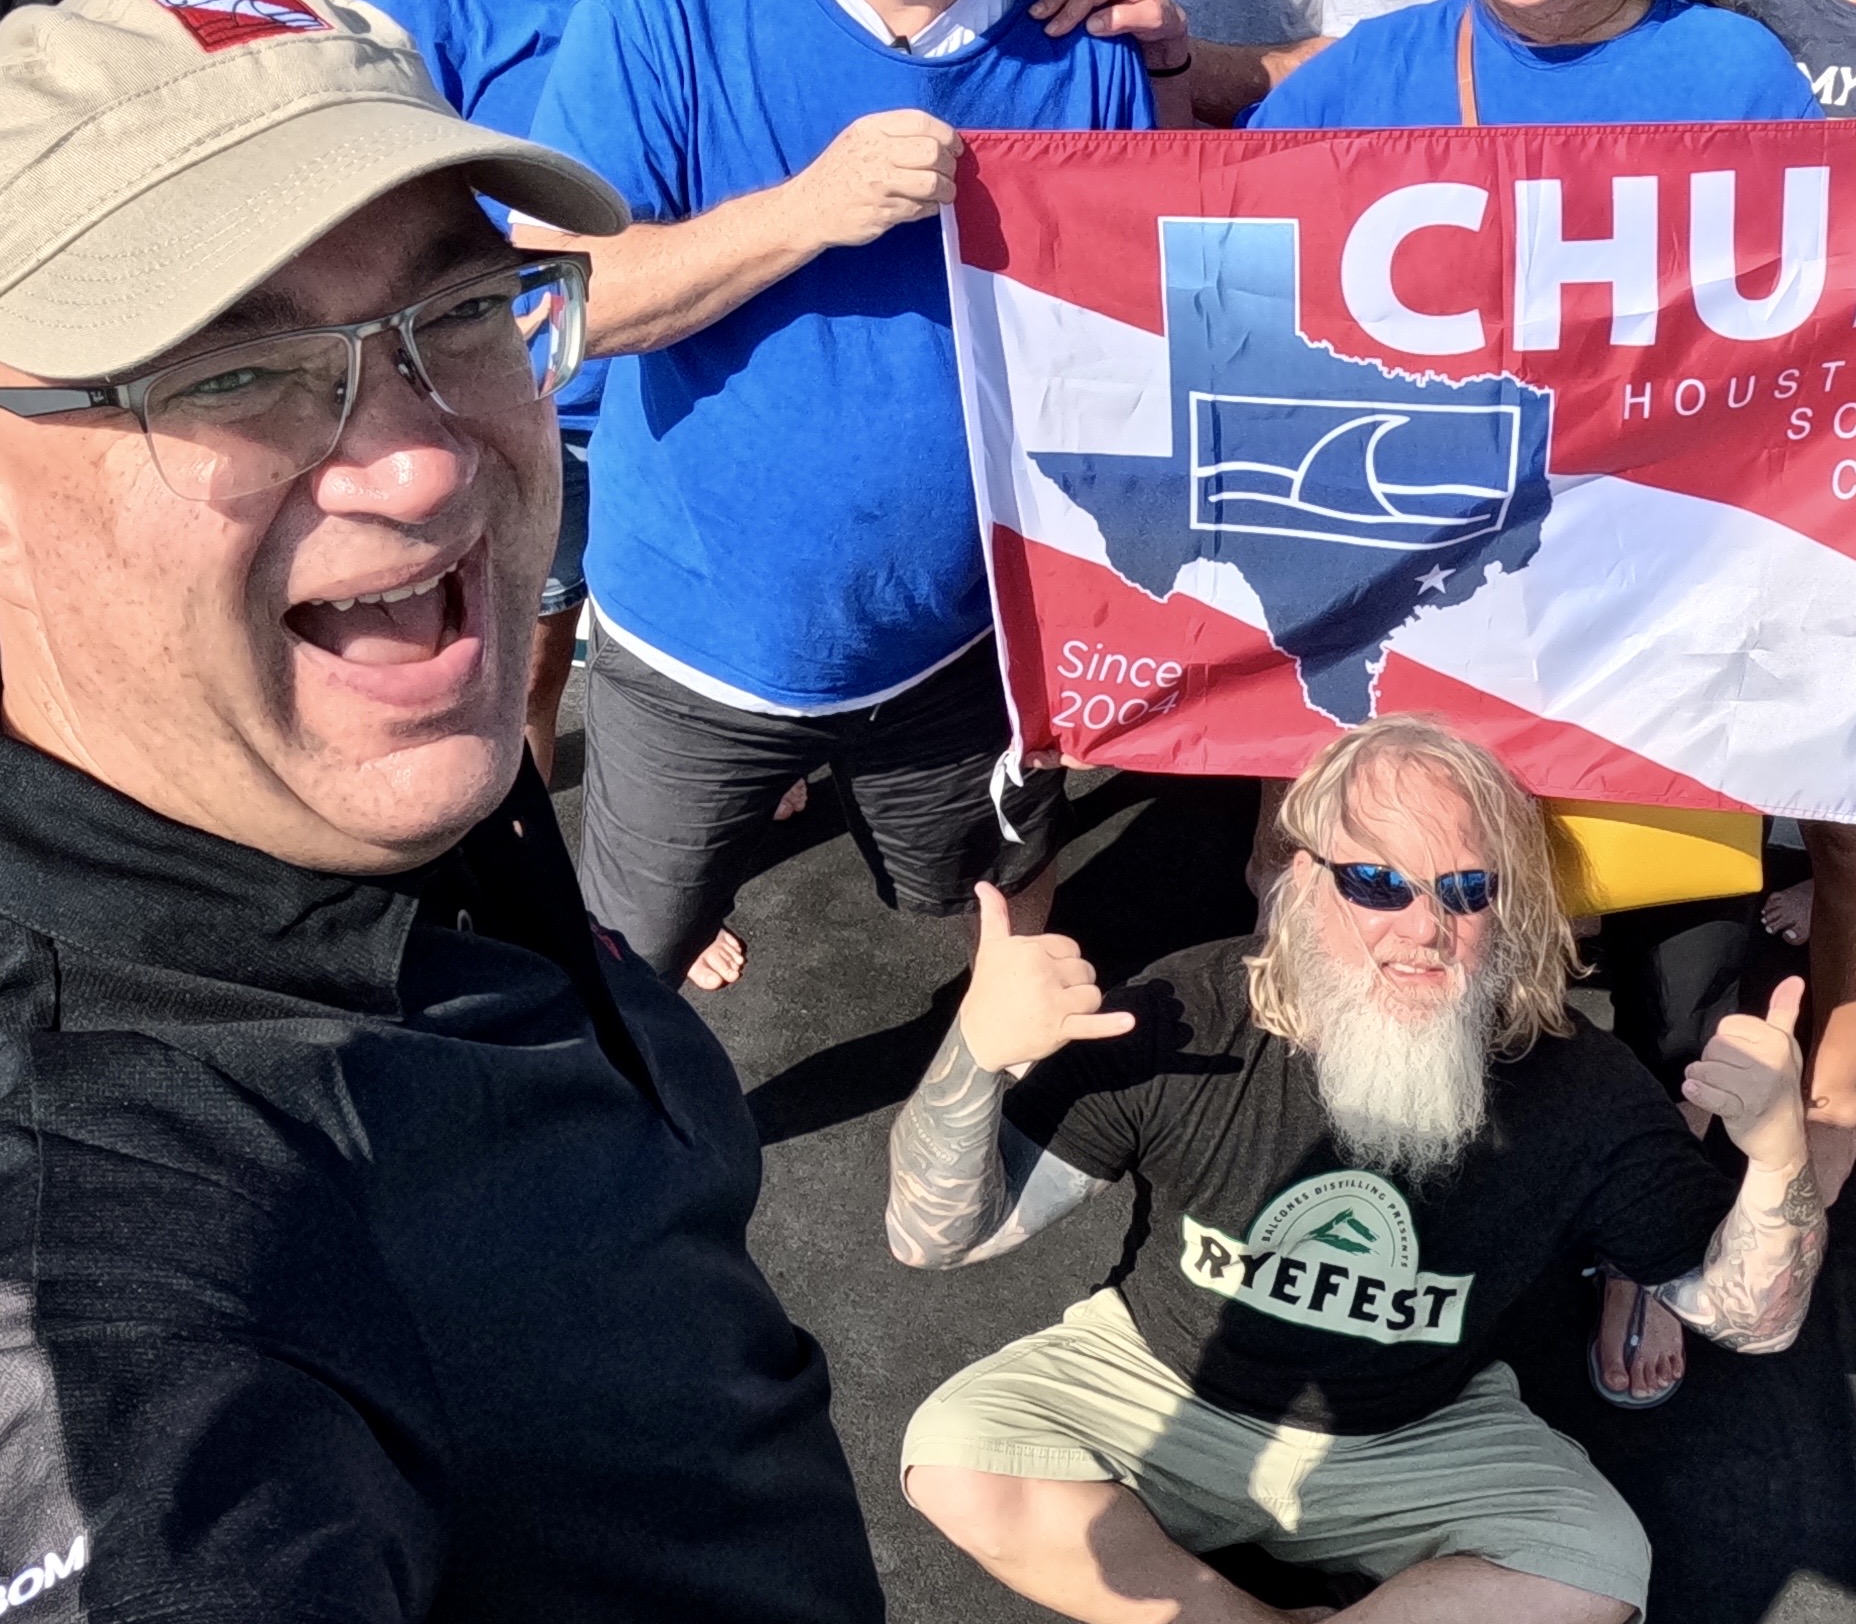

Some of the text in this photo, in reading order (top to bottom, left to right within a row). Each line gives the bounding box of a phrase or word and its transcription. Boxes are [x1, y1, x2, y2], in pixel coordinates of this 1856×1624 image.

[1056, 639, 1183, 688] Since
[1051, 689, 1181, 730] 2004
[1261, 1179, 1409, 1269] BALCONES DISTILLING PRESENTS
[1194, 1234, 1458, 1331] RYEFEST
